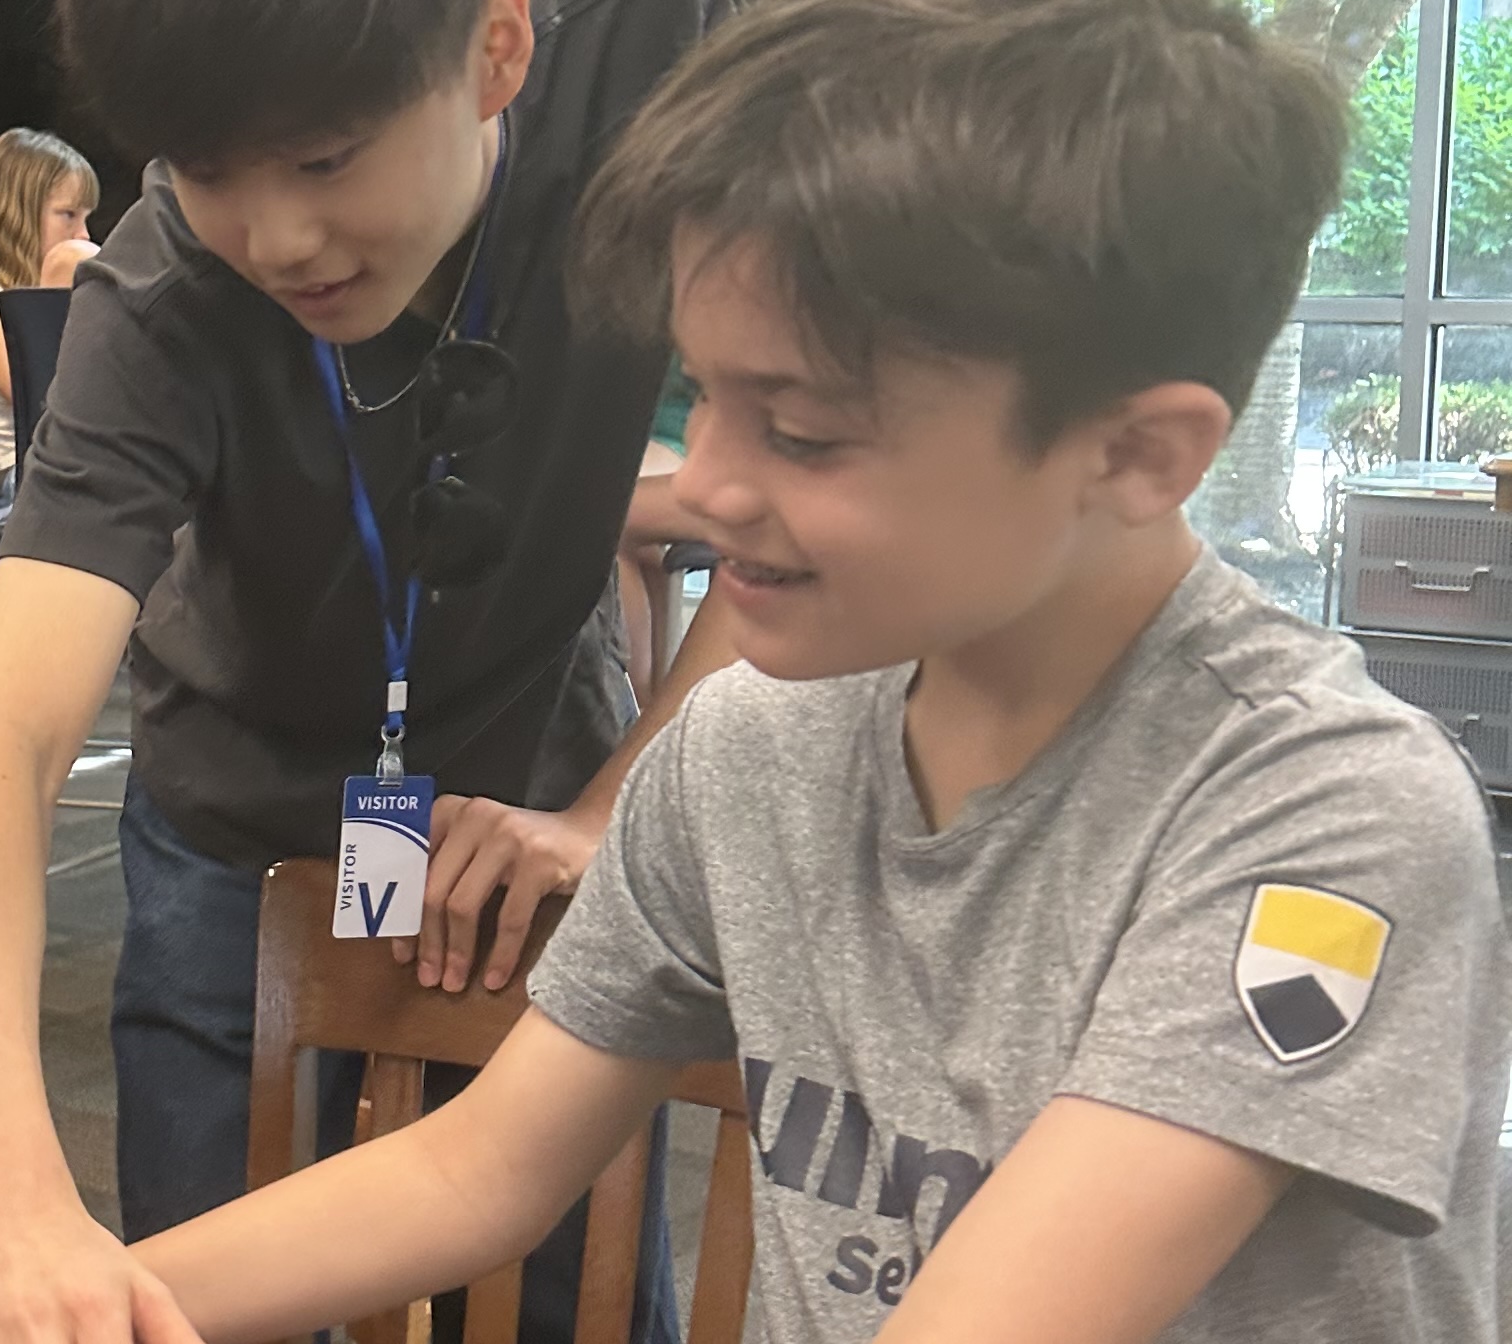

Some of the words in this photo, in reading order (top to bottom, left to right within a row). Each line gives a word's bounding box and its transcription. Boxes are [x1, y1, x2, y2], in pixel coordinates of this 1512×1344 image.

[357, 795, 418, 810] VISITOR
[340, 843, 357, 911] VISITOR
[358, 881, 398, 937] V
